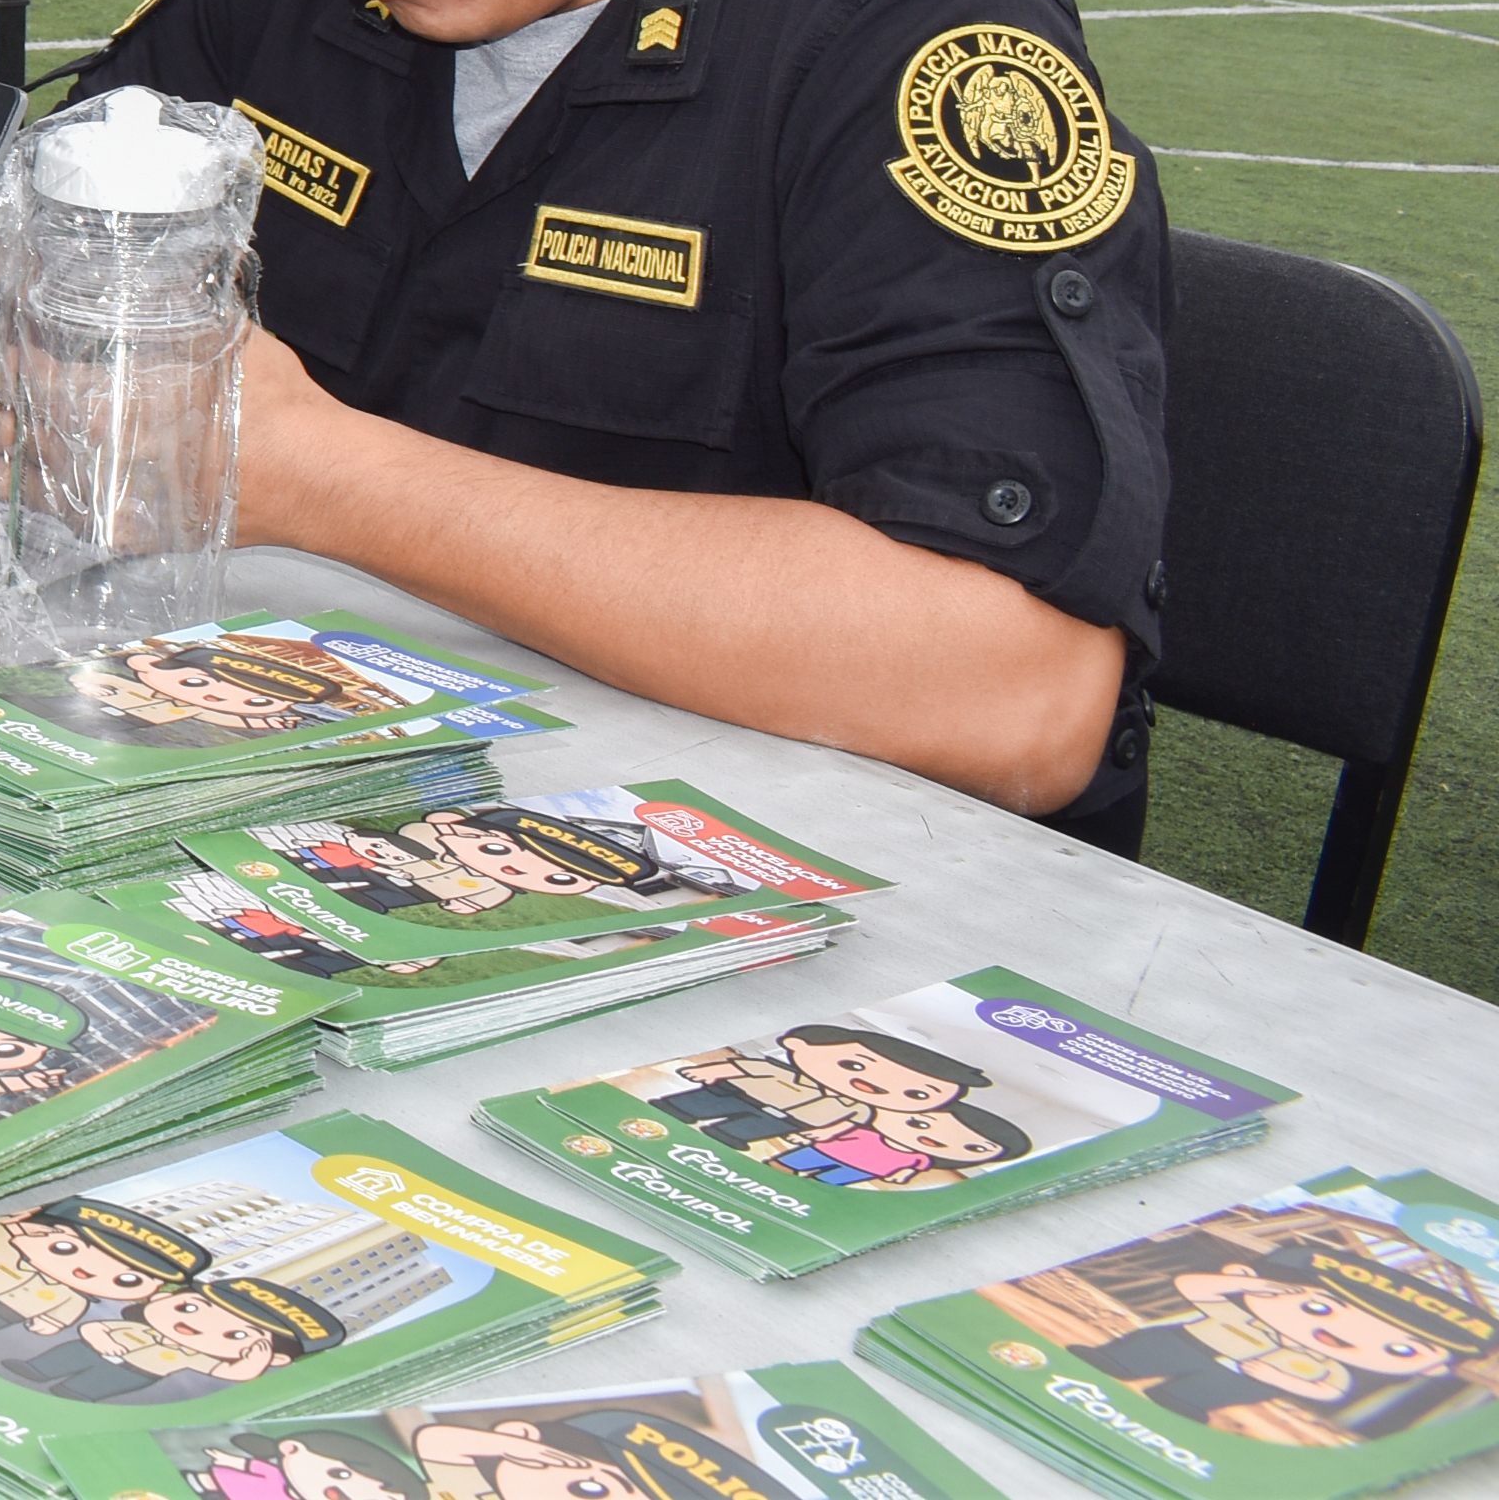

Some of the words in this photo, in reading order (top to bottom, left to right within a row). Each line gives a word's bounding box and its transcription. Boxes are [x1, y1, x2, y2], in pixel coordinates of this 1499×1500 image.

[909, 41, 970, 122] POLICIA
[977, 33, 1092, 117] NACIONAL
[265, 132, 325, 179] ARIAS
[917, 141, 1028, 212] AVIACION
[1038, 134, 1102, 211] POLICIAL
[308, 182, 337, 208] 2022
[904, 169, 934, 198] LEY
[937, 195, 994, 237] ORDEN
[1003, 222, 1039, 240] PAZ
[1043, 221, 1057, 239] Y
[1061, 163, 1126, 235] DESARROLLO
[539, 229, 598, 267] POLICIA
[598, 239, 687, 283] NACIONAL
[210, 656, 325, 693] POLICIA
[367, 658, 394, 669] DE
[394, 667, 465, 693] VIVIENDA
[389, 652, 487, 687] CONSTRUCCIÓN
[488, 684, 512, 693] Y/O
[9, 724, 99, 765] FOVIPOL
[516, 817, 641, 876] POLICIA
[688, 839, 713, 853] DE
[710, 850, 788, 886] HIPOTECA
[720, 834, 847, 892] CANCELACIÓN
[734, 849, 797, 881] COMPRA
[278, 888, 370, 943] FOVIPOL
[129, 971, 154, 984] A
[157, 978, 278, 1017] FUTURO
[149, 964, 188, 981] BIEN
[187, 976, 281, 1006] INMUEBLE
[161, 958, 252, 989] COMPRA
[253, 984, 283, 996] DE
[1066, 1040, 1097, 1055] CON
[1098, 1053, 1208, 1098] CONSTRUCCIÓN
[1076, 1036, 1140, 1065] COMPRA
[1140, 1062, 1157, 1070] DE
[1157, 1069, 1232, 1101] HIPOTECA
[1085, 1032, 1186, 1076] CANCELACIÓN
[1086, 1053, 1197, 1100] MEJORAMIENTO
[624, 1168, 754, 1233] FOVIPOL
[681, 1151, 812, 1216] FOVIPOL
[78, 1205, 197, 1268] POLICIA
[390, 1201, 449, 1229] BIEN
[445, 1223, 568, 1278] INMUEBLE
[412, 1193, 523, 1244] COMPRA
[523, 1238, 570, 1262] DE
[230, 1279, 330, 1341] POLICIA
[1312, 1252, 1495, 1341] POLICIA
[1064, 1380, 1215, 1480] FOVIPOL
[625, 1422, 768, 1500] POLI
